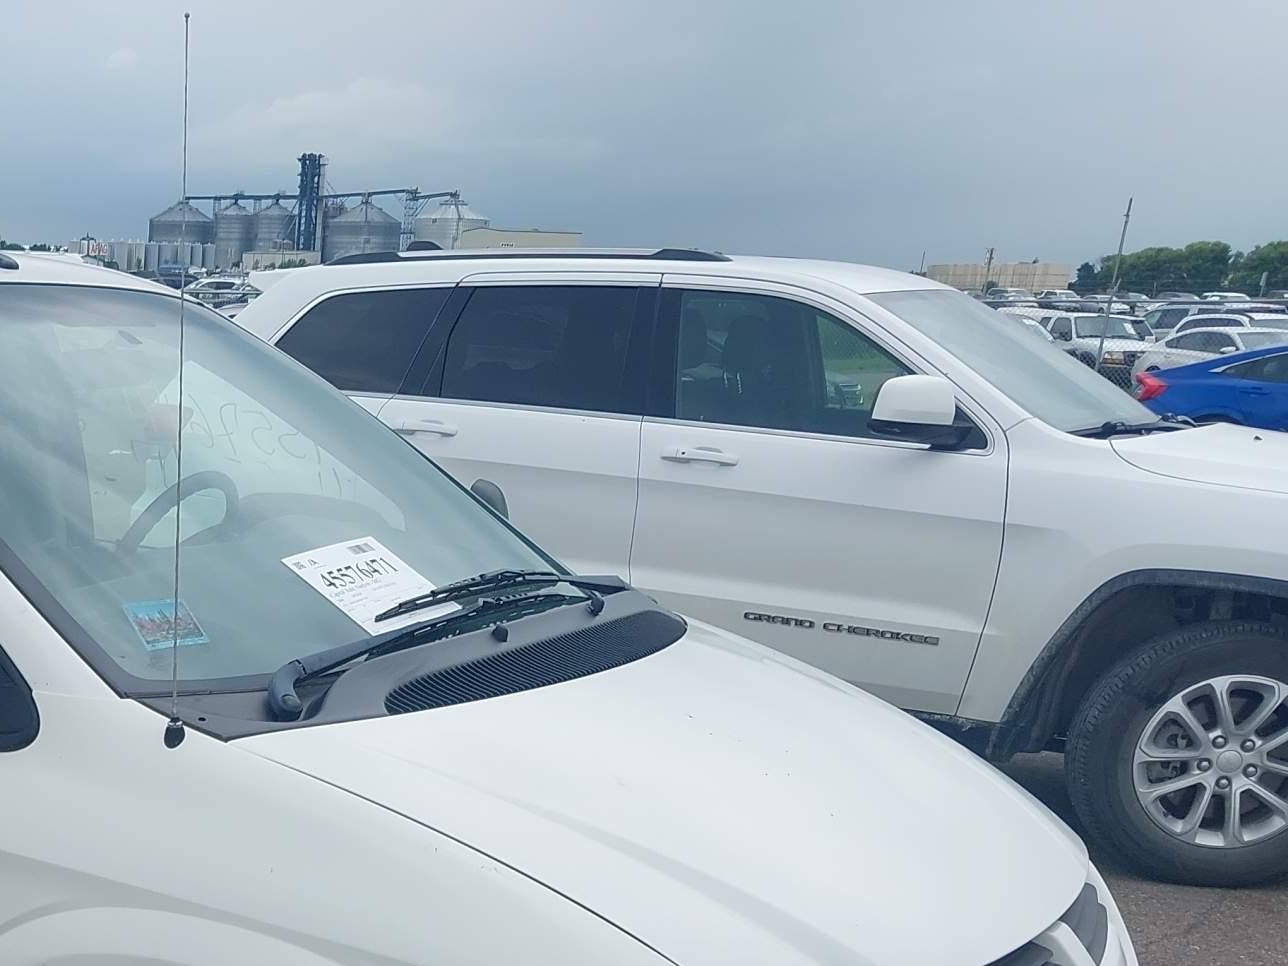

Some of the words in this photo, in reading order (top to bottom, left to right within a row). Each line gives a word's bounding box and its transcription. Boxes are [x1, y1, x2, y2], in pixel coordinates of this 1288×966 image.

[320, 557, 399, 589] 45576471
[744, 611, 815, 629] GRAND
[823, 622, 940, 646] CHEROKEE
